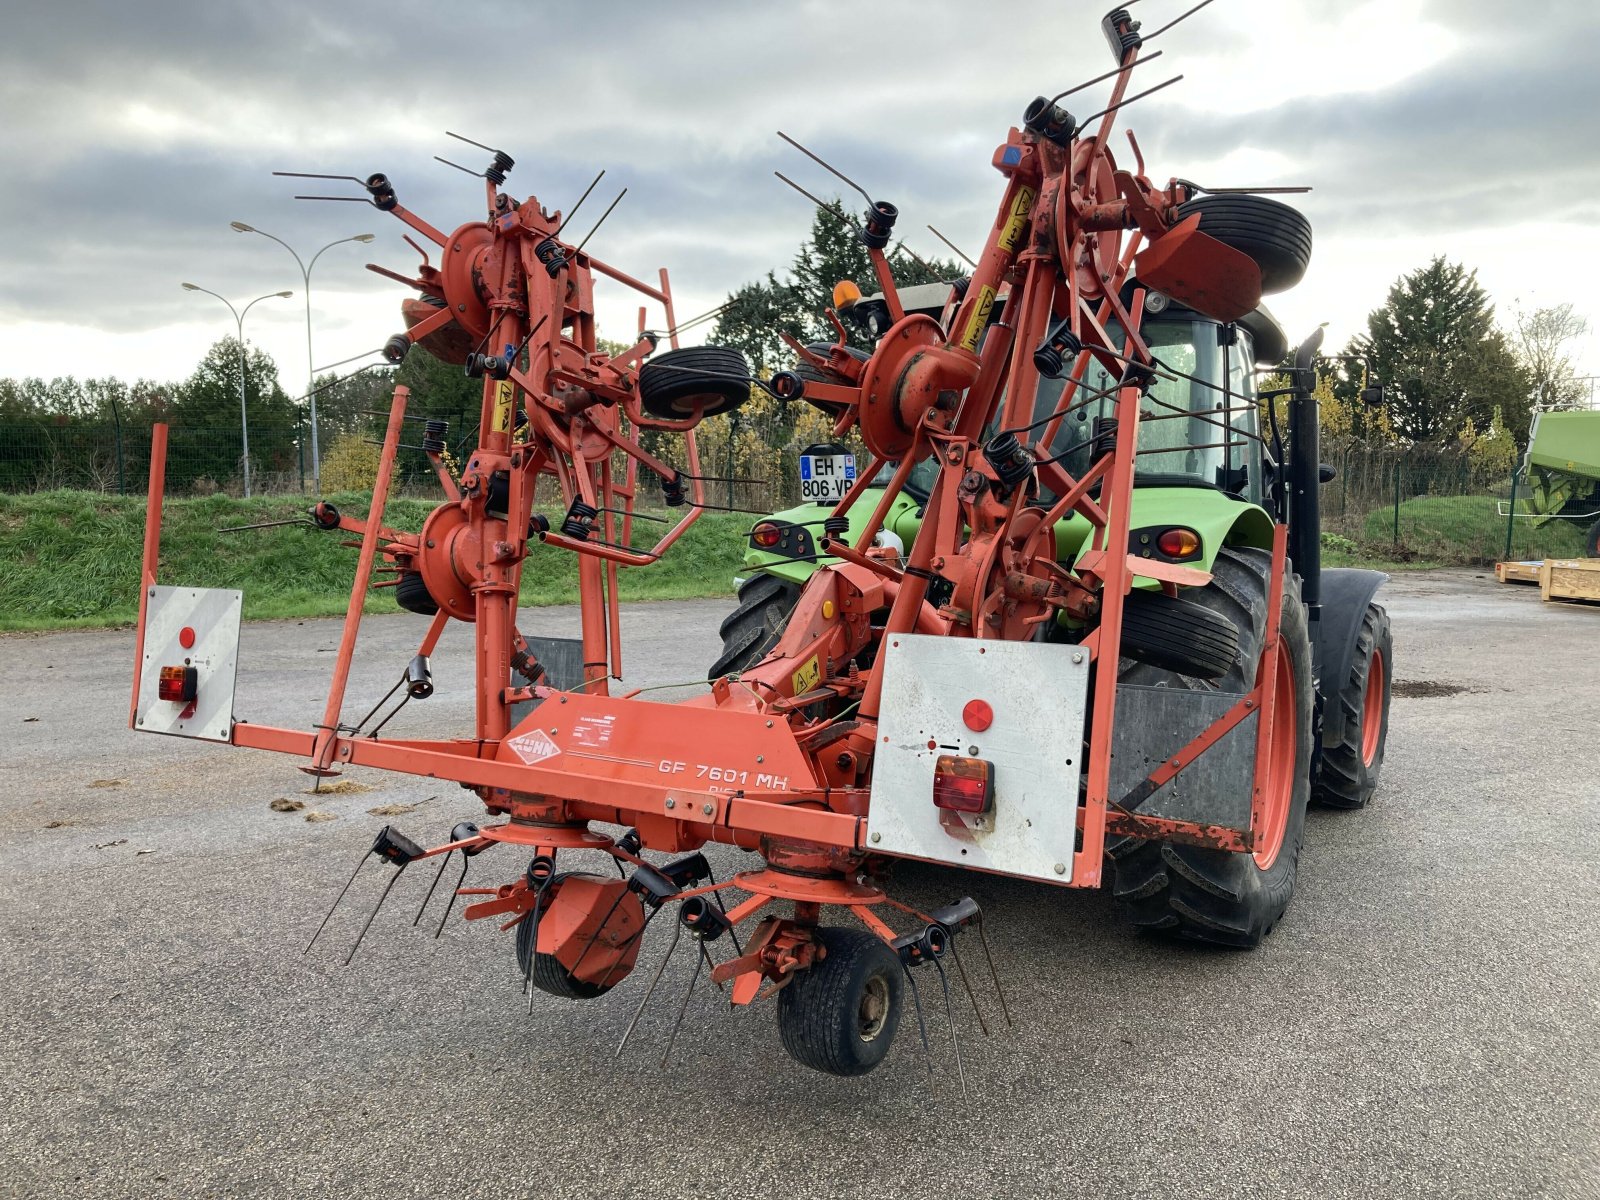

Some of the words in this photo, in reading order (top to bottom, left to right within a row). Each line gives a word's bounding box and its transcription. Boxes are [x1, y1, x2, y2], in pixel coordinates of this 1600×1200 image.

[658, 759, 687, 774] GF
[695, 764, 748, 785] 7601
[755, 773, 789, 791] MH
